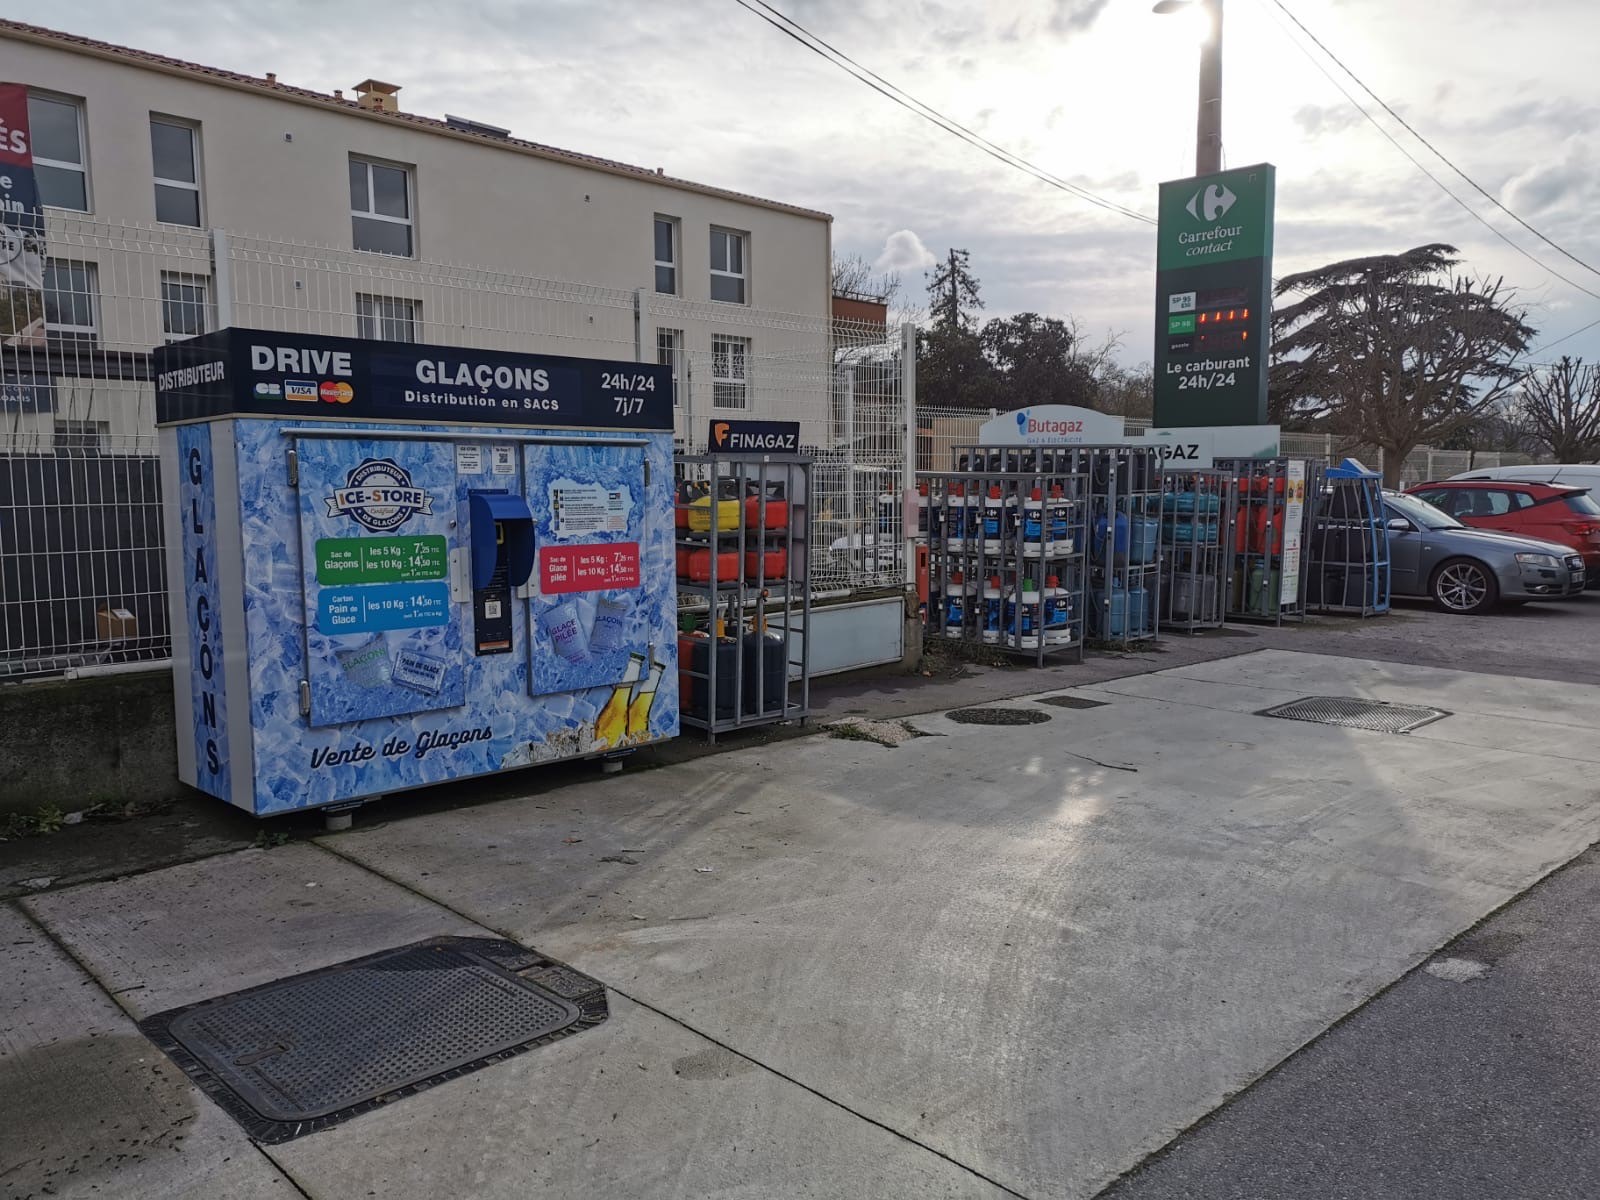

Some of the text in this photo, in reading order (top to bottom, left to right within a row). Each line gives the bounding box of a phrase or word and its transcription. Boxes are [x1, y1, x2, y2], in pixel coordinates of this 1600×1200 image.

[1178, 225, 1243, 244] Carrefour
[1186, 239, 1233, 257] contact
[250, 344, 354, 376] DRIVE
[1166, 356, 1250, 374] Le carburant
[158, 361, 225, 392] DISTRIBUTEUR
[415, 359, 550, 394] GLAÇONS
[601, 372, 656, 392] 24h/24
[1178, 372, 1236, 390] 24h/24
[291, 386, 313, 395] VISA
[404, 389, 560, 412] Distribution en SACS
[613, 396, 645, 417] 7j/7
[1027, 418, 1084, 436] Butagaz
[730, 433, 796, 449] FINAGAZ
[355, 465, 403, 481] DISTRIBUTEUR
[339, 489, 422, 506] ICE-STORE
[362, 513, 372, 523] DE
[330, 551, 342, 559] Sac
[369, 546, 382, 556] les
[383, 546, 389, 555] 5
[390, 546, 401, 556] Kg
[590, 555, 595, 564] 5
[596, 555, 605, 564] Kg
[324, 560, 359, 571] Glaçons
[366, 560, 378, 569] les
[380, 560, 390, 569] 10
[391, 559, 402, 570] Kg
[549, 564, 568, 573] Glace
[588, 567, 596, 575] 10
[596, 567, 605, 576] Kg
[188, 447, 220, 776] GLAÇONS
[328, 604, 358, 614] Pain de
[368, 601, 380, 610] les
[382, 600, 392, 609] 10
[393, 600, 404, 610] Kg
[332, 615, 356, 625] Glace
[551, 618, 577, 635] GLACE
[310, 725, 493, 769] Vente de Glaçons
